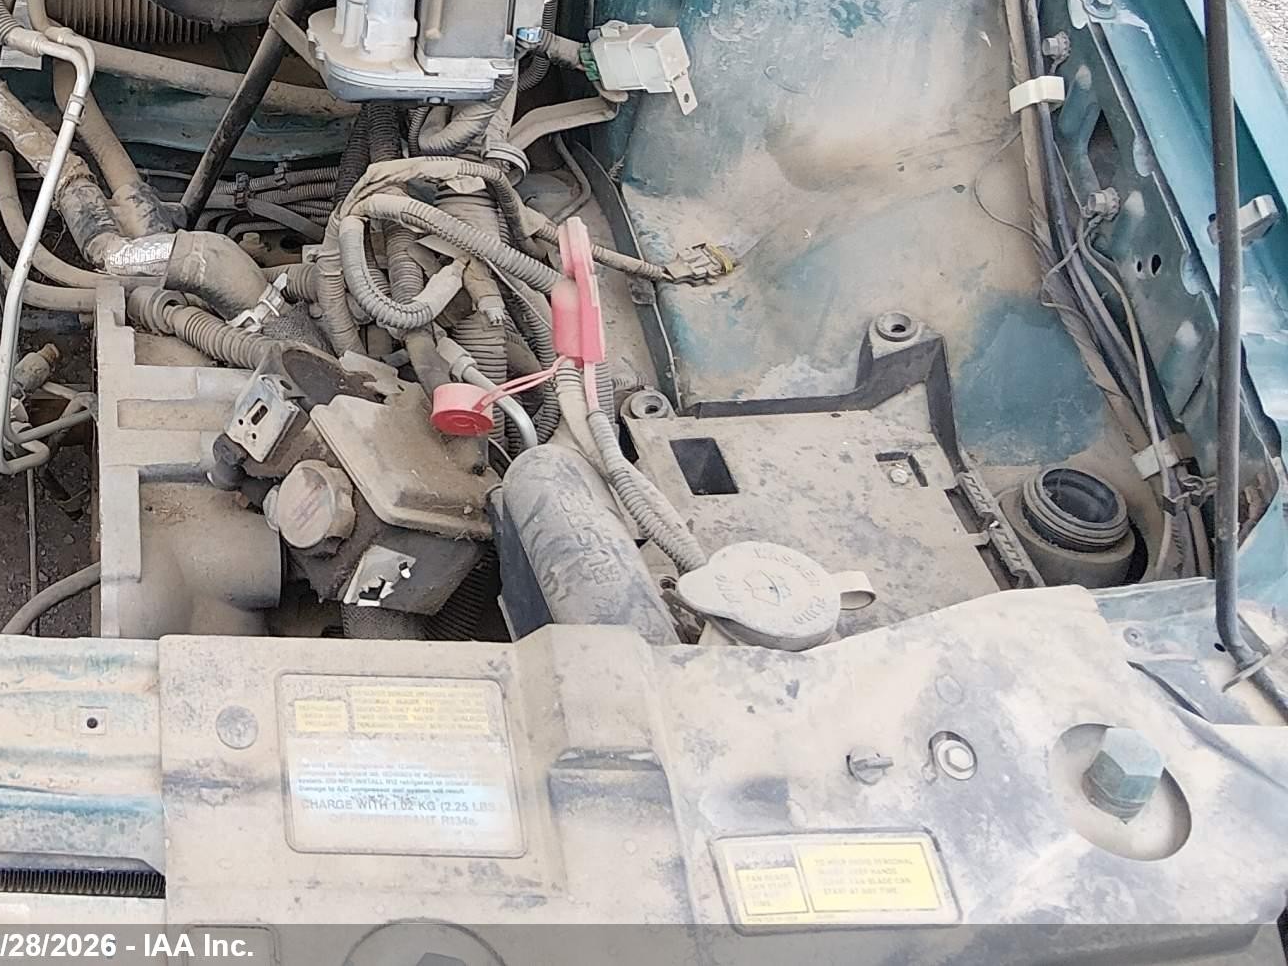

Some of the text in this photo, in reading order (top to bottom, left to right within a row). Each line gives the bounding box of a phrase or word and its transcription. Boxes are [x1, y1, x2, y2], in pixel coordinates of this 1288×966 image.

[298, 785, 327, 794] Damage
[302, 799, 353, 811] CHARGE
[357, 798, 388, 811] WITH
[392, 799, 414, 811] 1.02
[417, 801, 436, 811] KG
[440, 801, 469, 812] (2.25
